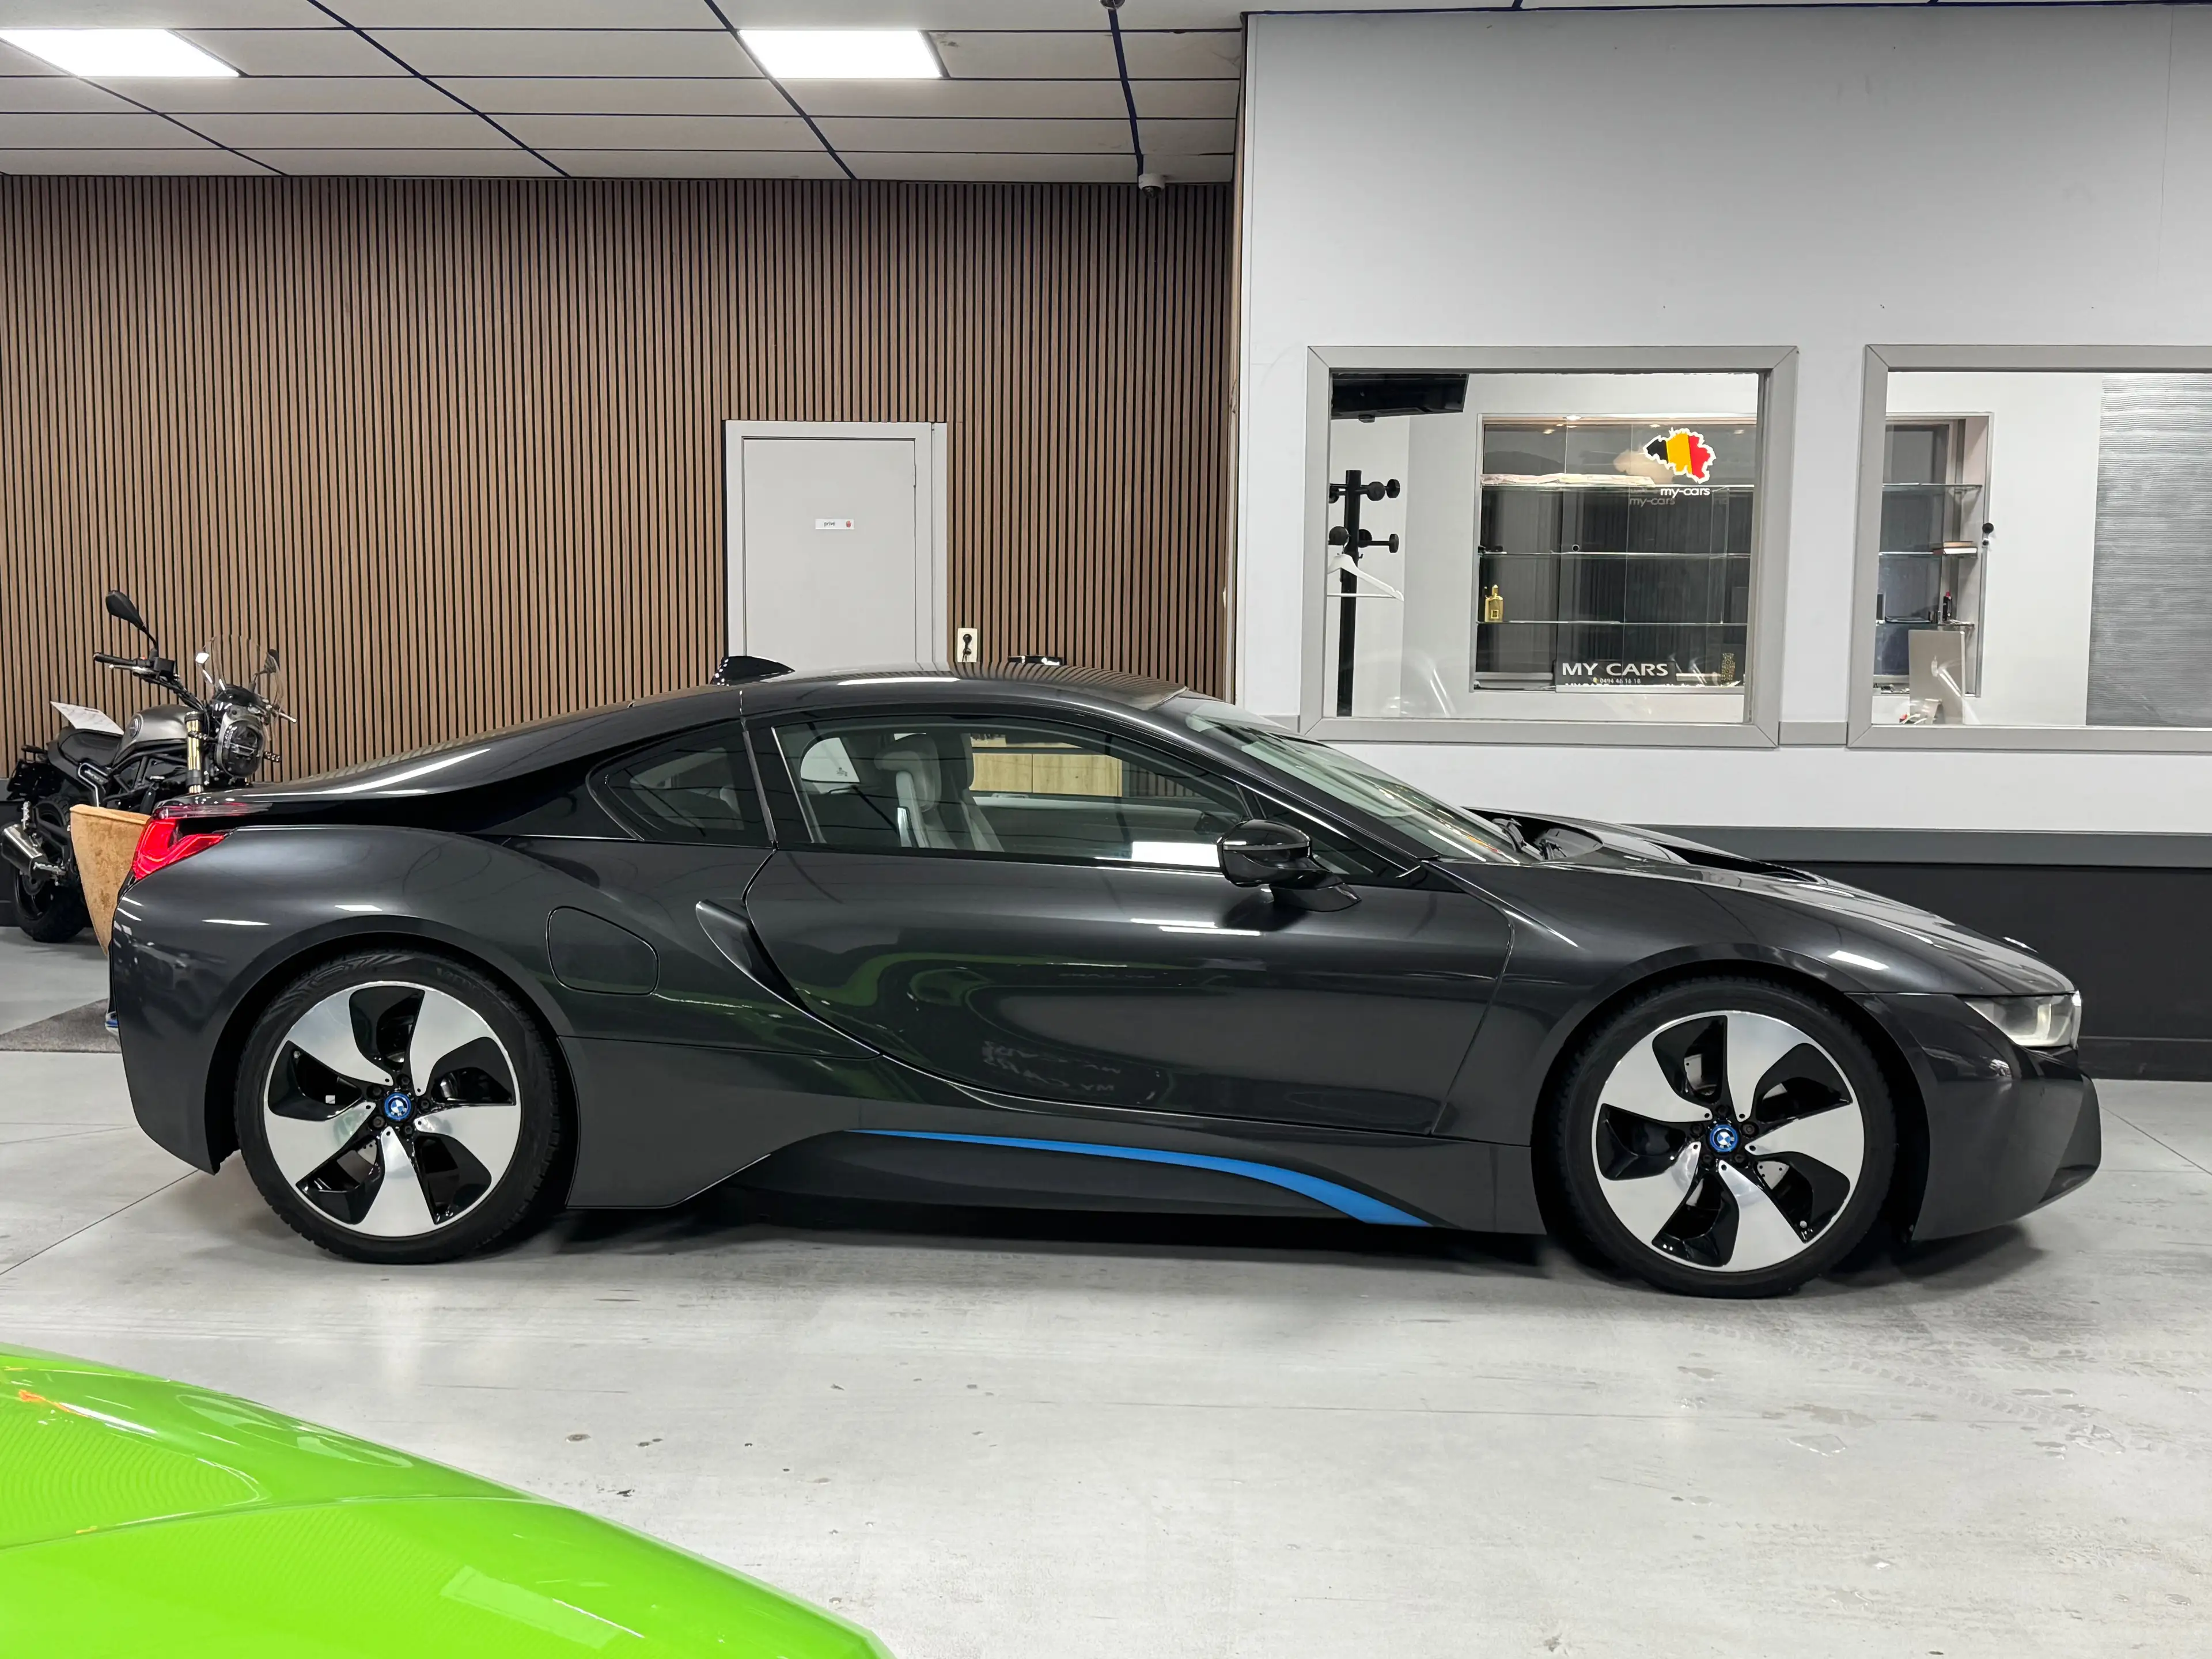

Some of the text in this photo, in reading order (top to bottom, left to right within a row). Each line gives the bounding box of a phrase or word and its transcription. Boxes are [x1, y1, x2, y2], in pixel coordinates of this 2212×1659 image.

[1660, 487, 1710, 499] my-cars
[1562, 662, 1668, 676] MY CARS
